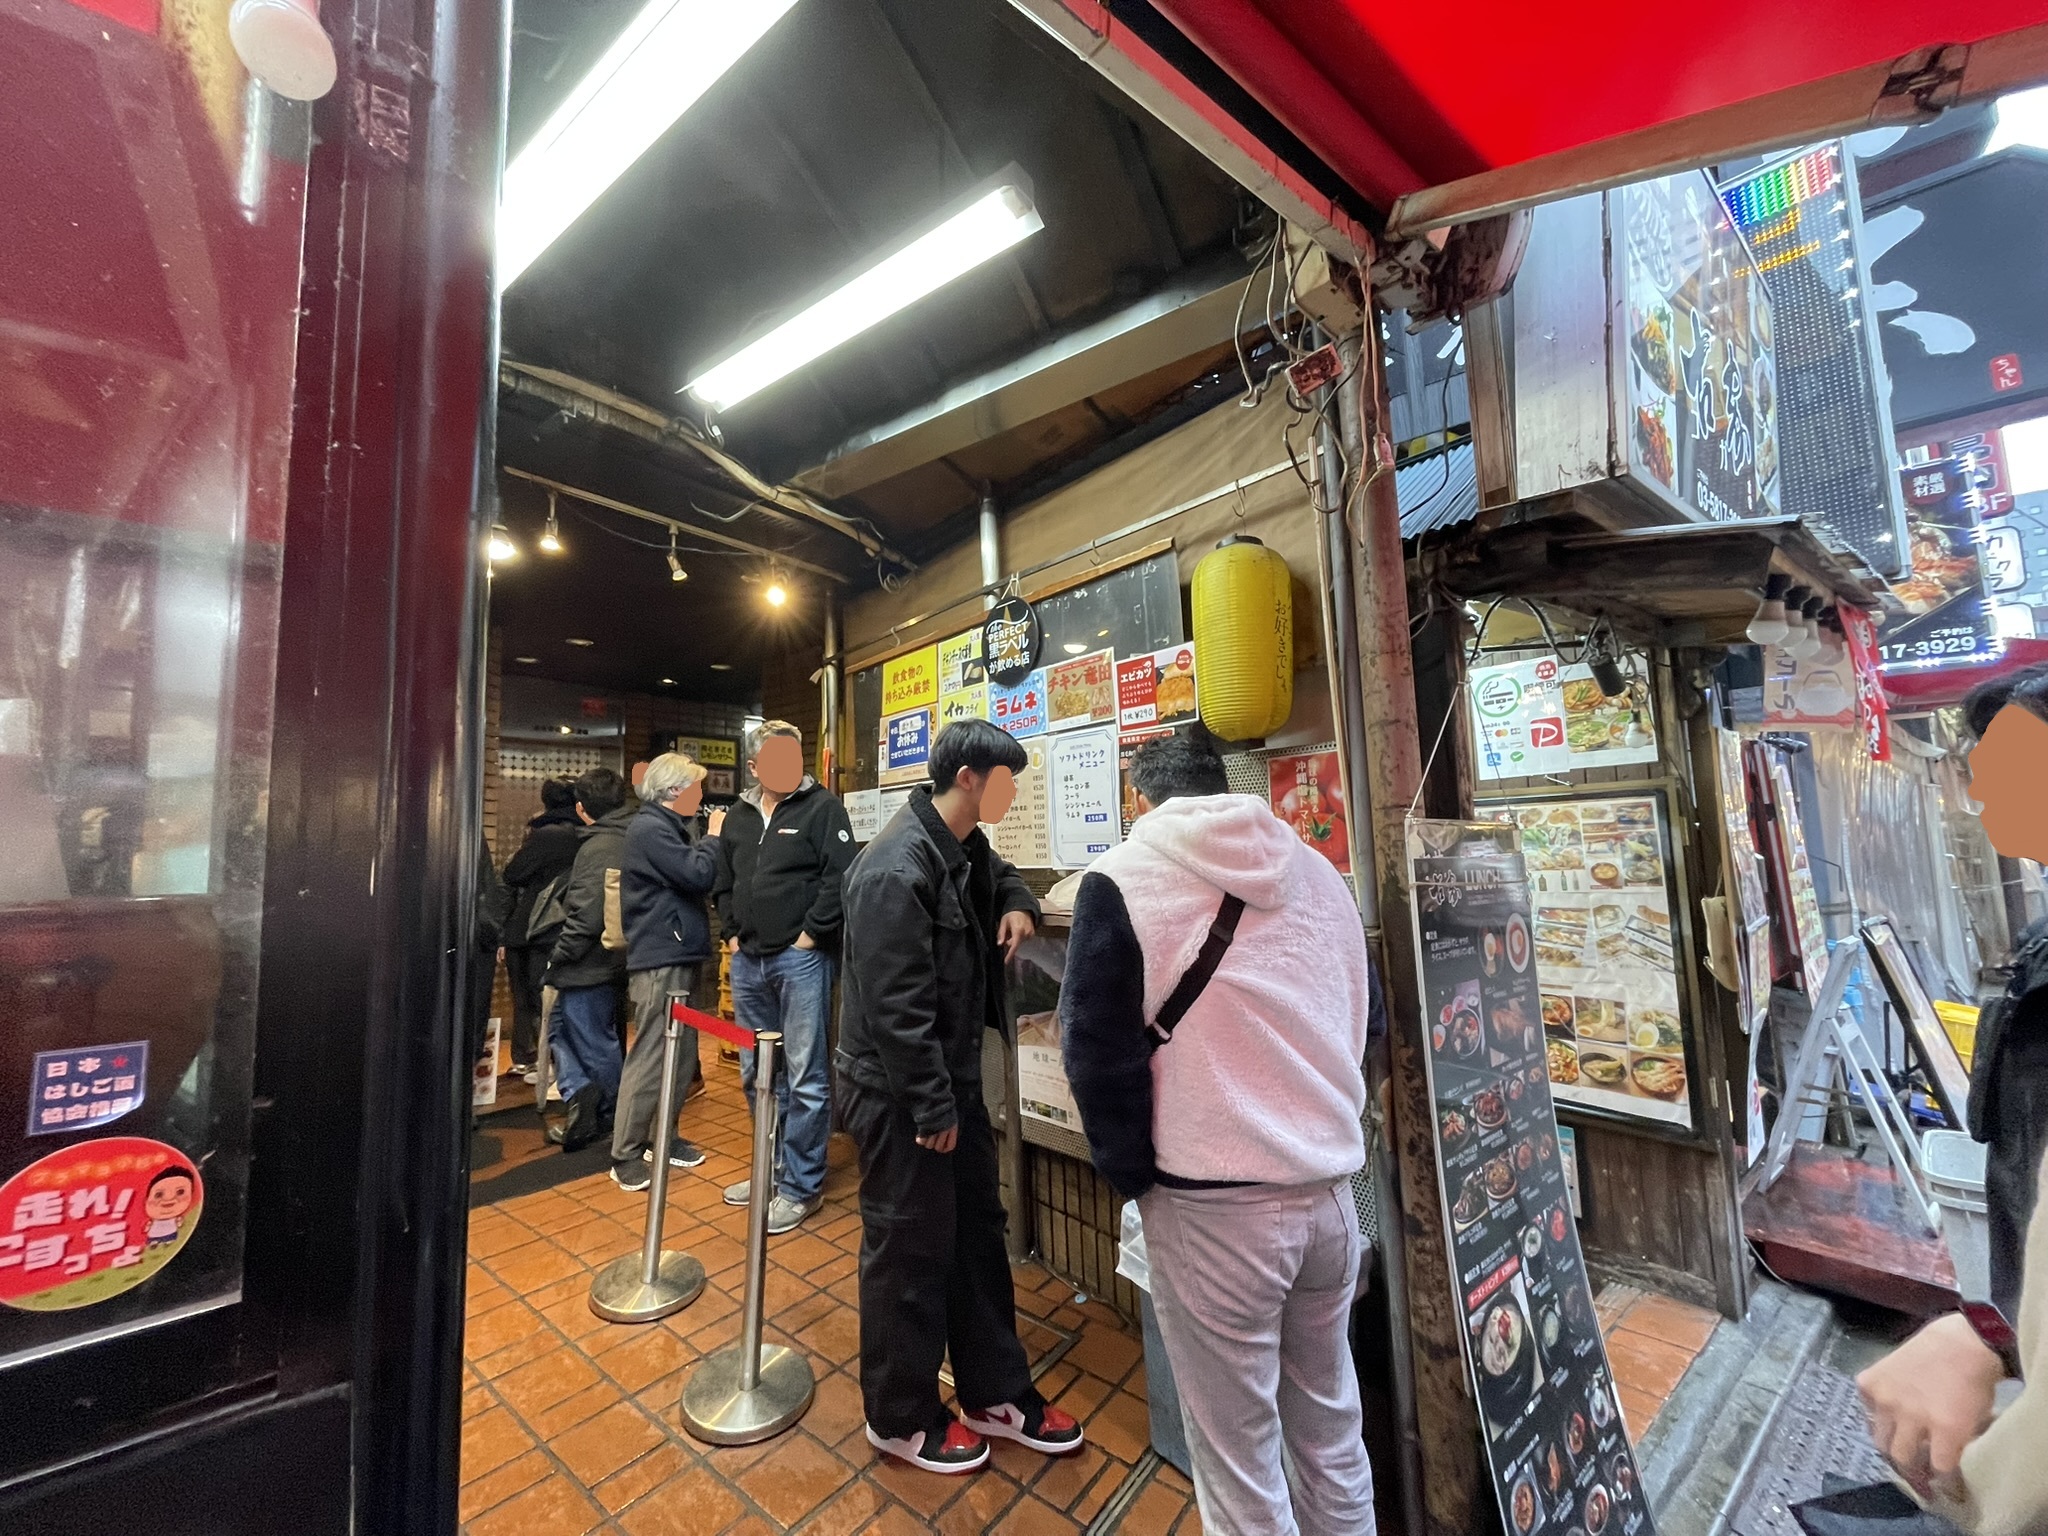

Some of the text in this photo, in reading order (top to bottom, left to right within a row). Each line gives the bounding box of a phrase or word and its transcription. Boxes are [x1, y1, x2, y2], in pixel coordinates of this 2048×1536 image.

[1995, 356, 2016, 388] ちゃん
[1697, 481, 1741, 521] 03-5817-
[988, 621, 1028, 643] PERFECT
[988, 633, 1029, 659] 黒ラベル
[1879, 636, 1976, 659] 17-3929
[988, 651, 1030, 675] が飲める店
[892, 664, 924, 685] 飲食物の
[1120, 667, 1152, 683] エビカツ
[885, 679, 930, 705] 持ち込み厳禁
[996, 691, 1037, 717] ラムネ
[897, 732, 918, 748] お休み
[1059, 749, 1105, 763] ソフトドリンク
[1079, 761, 1105, 769] メニュー
[1464, 869, 1502, 891] LUNCH
[46, 1057, 103, 1078] 日本
